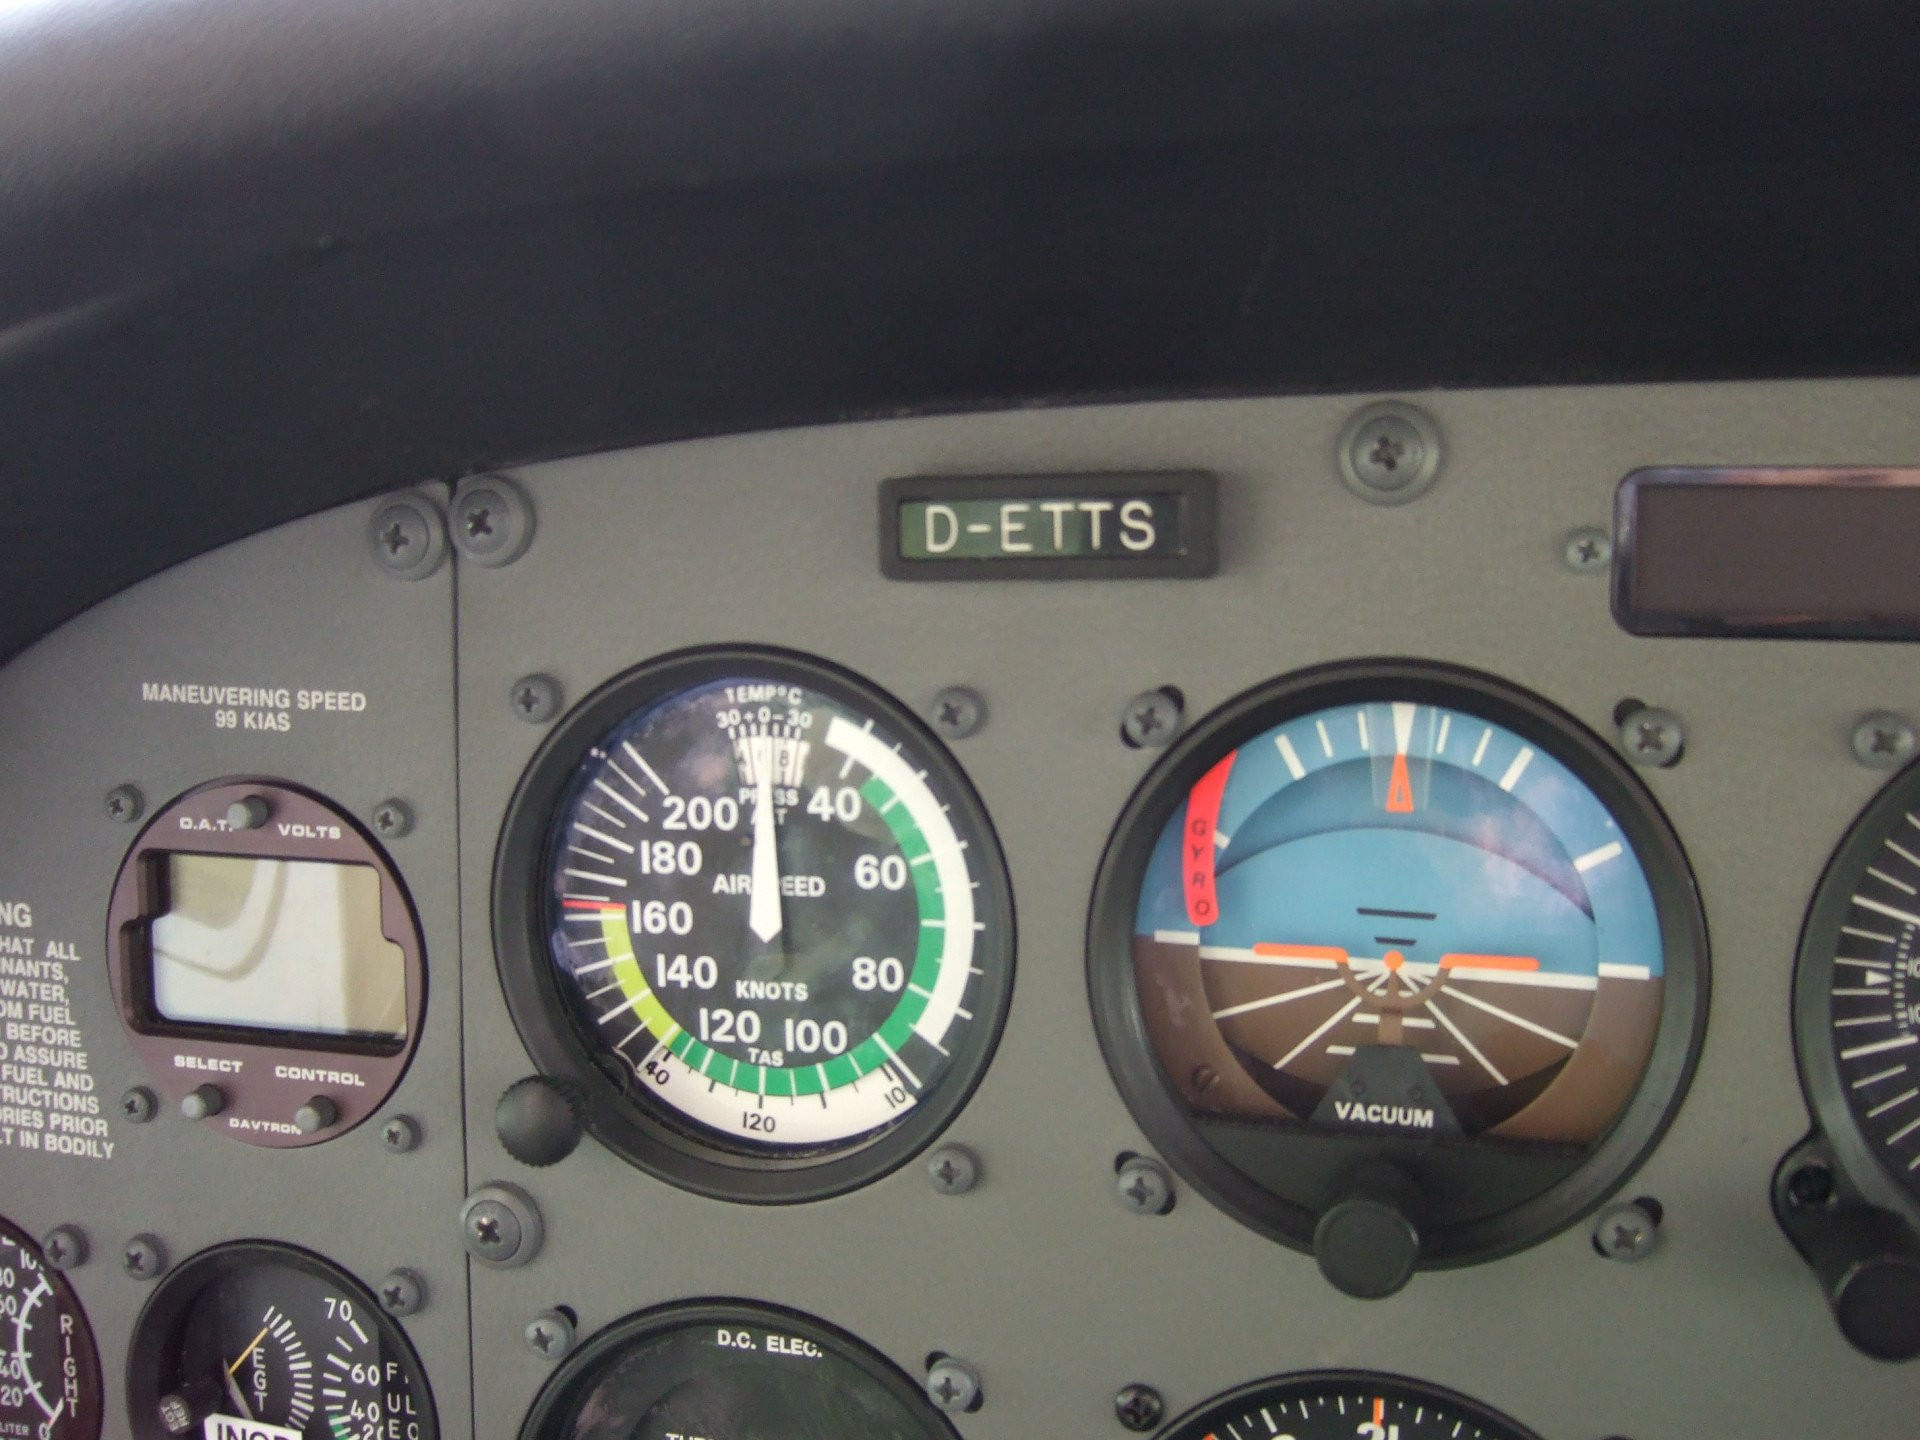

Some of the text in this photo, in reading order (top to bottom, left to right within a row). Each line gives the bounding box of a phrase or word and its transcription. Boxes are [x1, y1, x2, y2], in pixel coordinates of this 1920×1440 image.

[925, 501, 1156, 553] D-ETTS
[142, 682, 367, 712] MANEUVERING SPEED
[215, 710, 291, 732] 99 KIAS
[662, 796, 739, 831] 200
[807, 786, 861, 822] 40
[278, 823, 341, 839] VOLTS
[640, 841, 702, 875] 180
[854, 855, 907, 890] 60
[712, 873, 826, 898] AIREED
[632, 901, 693, 935] 160
[45, 940, 81, 960] ALL
[656, 954, 718, 988] 140
[851, 957, 905, 992] 80
[1, 978, 69, 1006] WATER,
[735, 980, 808, 1001] KNOTS
[28, 1003, 76, 1026] FUEL
[699, 1009, 761, 1043] 120
[6, 1022, 82, 1048] BEFORE
[784, 1019, 847, 1054] 100
[14, 1044, 88, 1070] ASSURE
[174, 1054, 365, 1087] SELECT CONTROL
[747, 1048, 784, 1067] TAS
[2, 1063, 94, 1092] FUEL AND
[0, 1105, 108, 1137] RIES PRIOR
[229, 1117, 302, 1136] DAVTRON
[742, 1111, 776, 1133] 120
[1334, 1101, 1435, 1129] VACUUM
[20, 1130, 39, 1149] IN
[45, 1132, 115, 1159] BODILY
[325, 1297, 352, 1321] 70
[717, 1329, 823, 1358] D.C. ELEC.
[60, 1313, 78, 1418] RIGHT
[252, 1347, 268, 1412] EGT
[351, 1363, 380, 1387] 60
[0, 1385, 23, 1407] 20
[350, 1399, 380, 1423] 40
